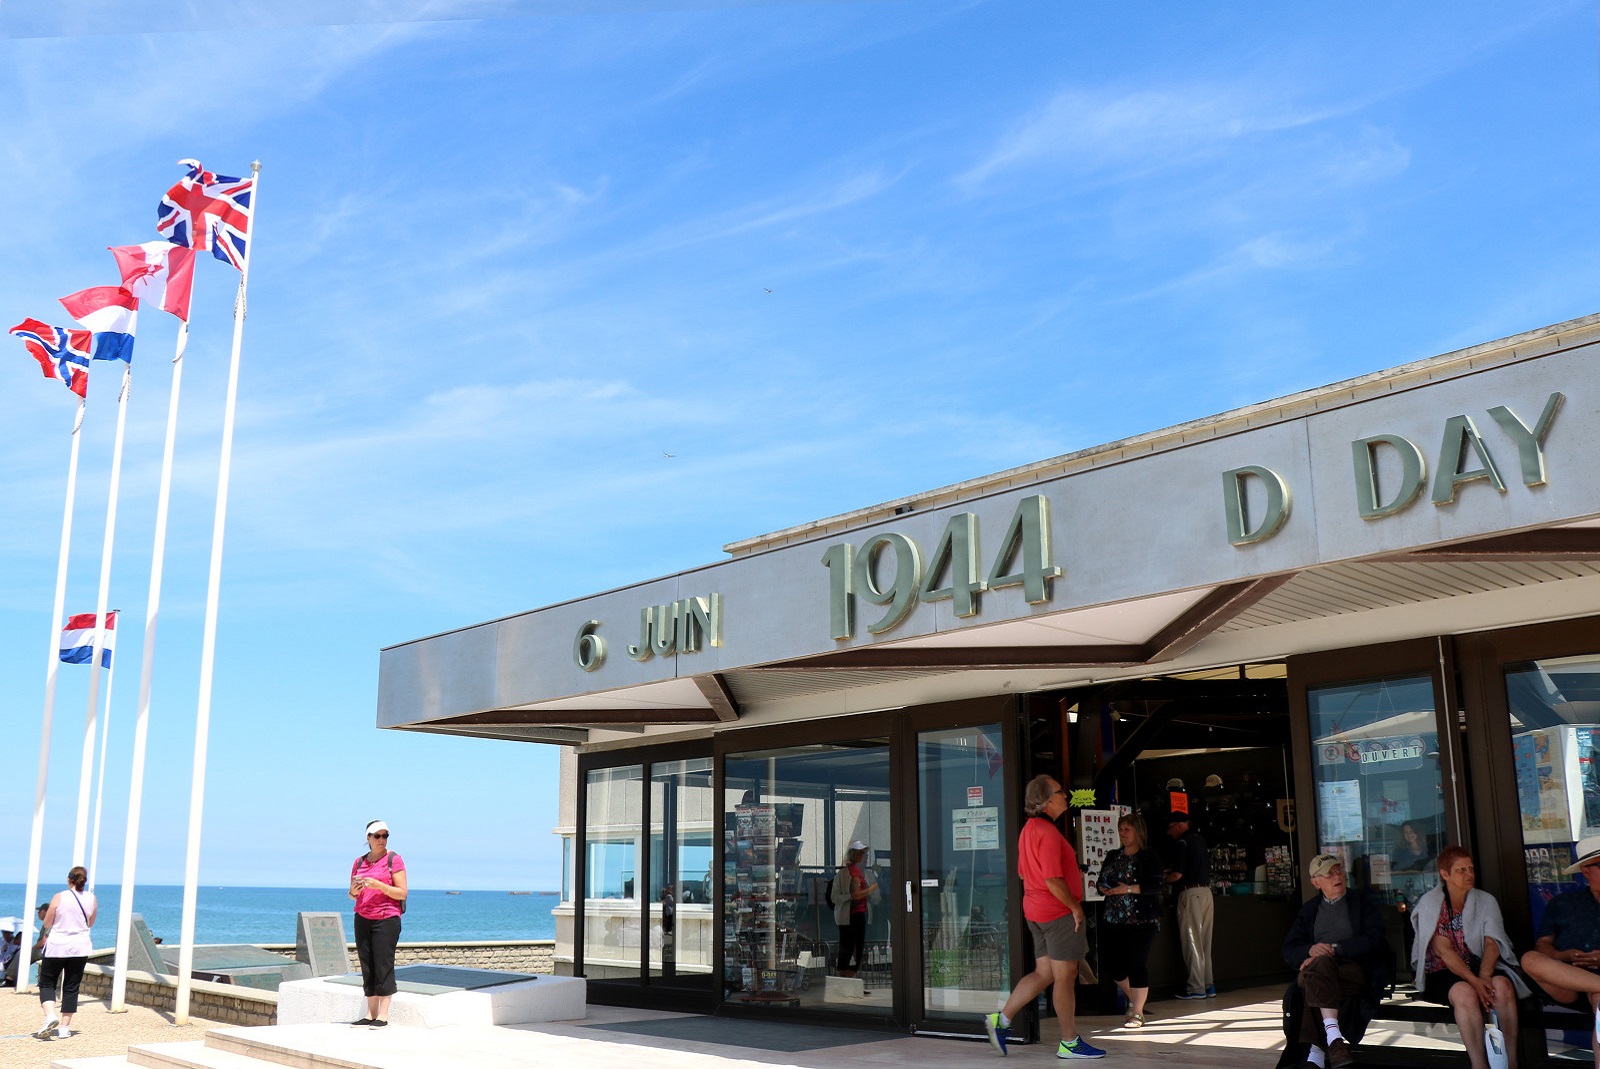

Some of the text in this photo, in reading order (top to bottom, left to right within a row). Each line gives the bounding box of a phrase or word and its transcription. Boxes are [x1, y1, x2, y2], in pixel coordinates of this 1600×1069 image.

[573, 391, 1567, 672] 6 JUIN 1944 D DAY
[1361, 746, 1419, 763] OUVERT
